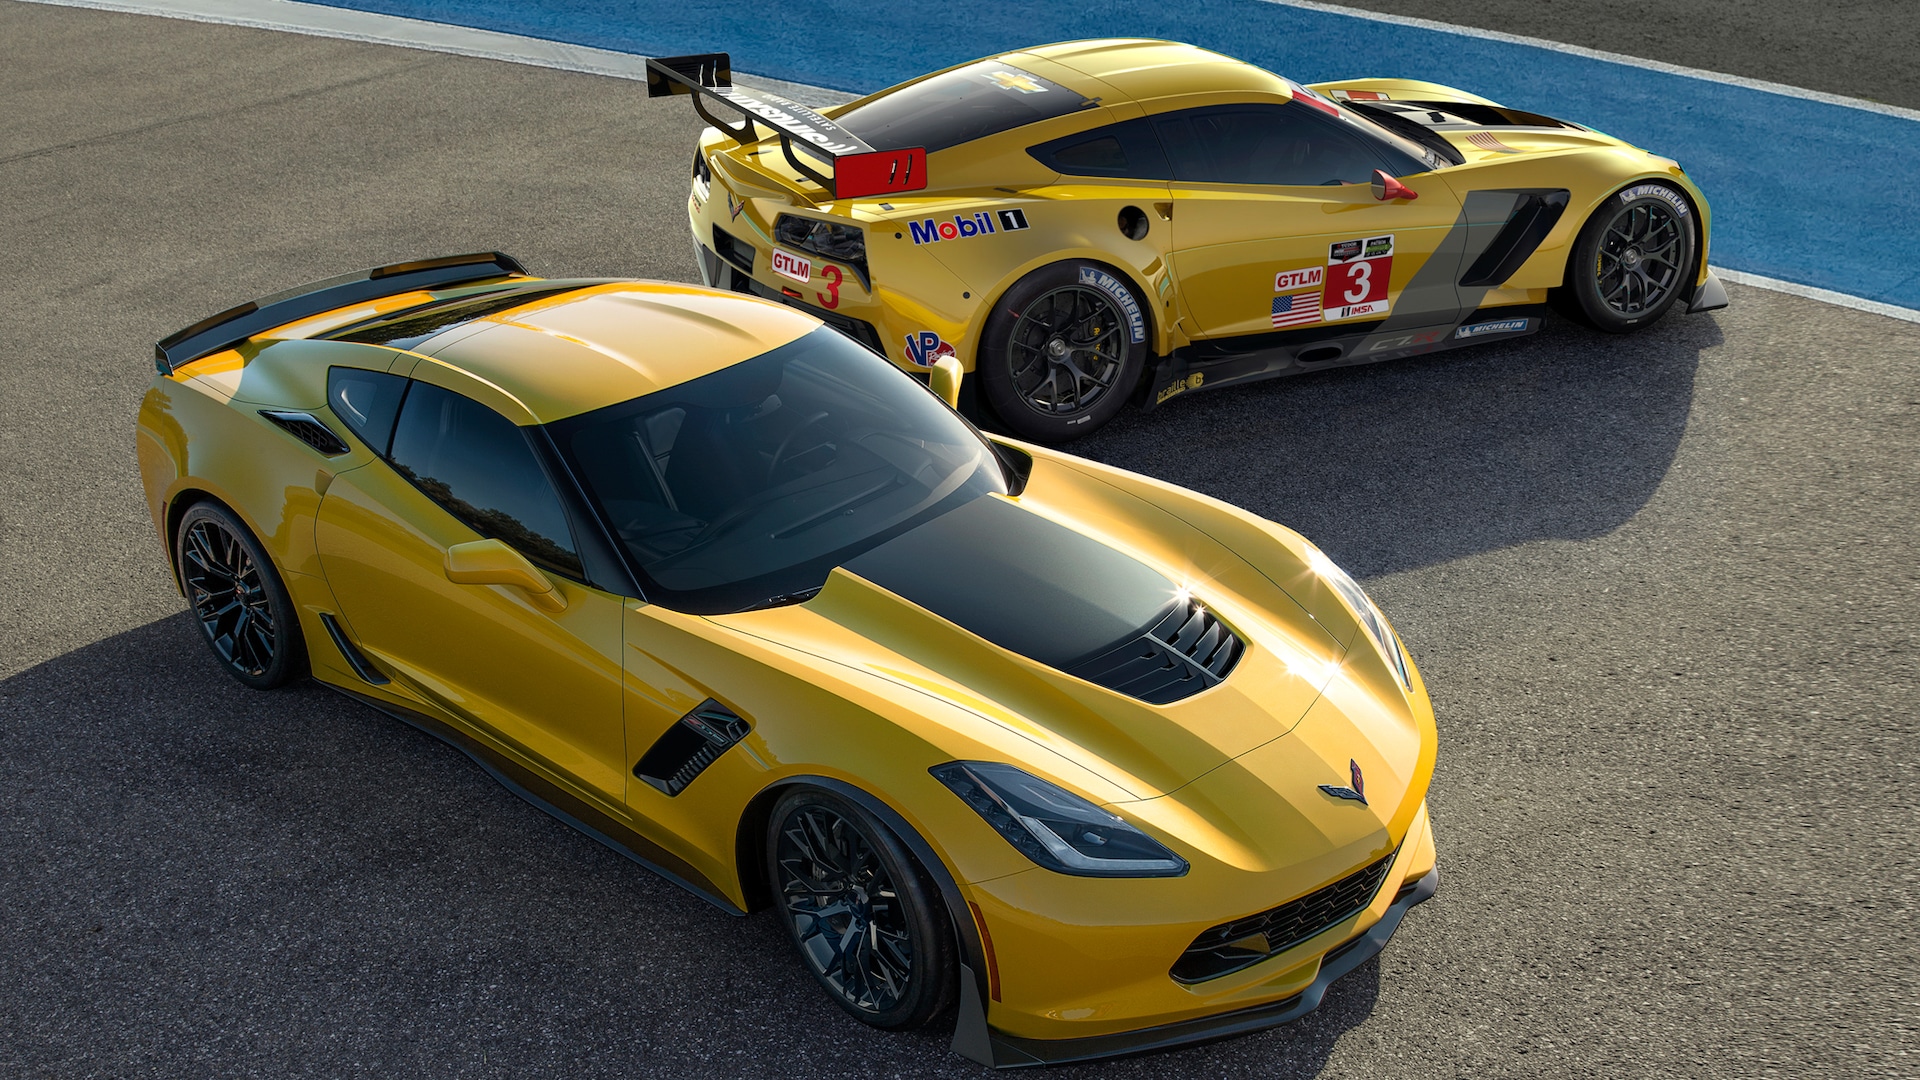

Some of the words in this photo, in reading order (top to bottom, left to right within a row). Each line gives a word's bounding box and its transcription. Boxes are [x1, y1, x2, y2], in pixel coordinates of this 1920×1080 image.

[1636, 185, 1688, 214] MICHELIN
[909, 211, 995, 245] Mobil
[773, 252, 810, 279] GTLM
[1276, 268, 1322, 288] GTLM
[816, 264, 843, 310] 3
[1343, 261, 1372, 303] 3
[1098, 274, 1145, 341] MICHELIN
[1351, 305, 1374, 315] IMSA
[1472, 320, 1525, 333] MICHELIN
[905, 332, 940, 367] VP
[1156, 378, 1187, 401] braille
